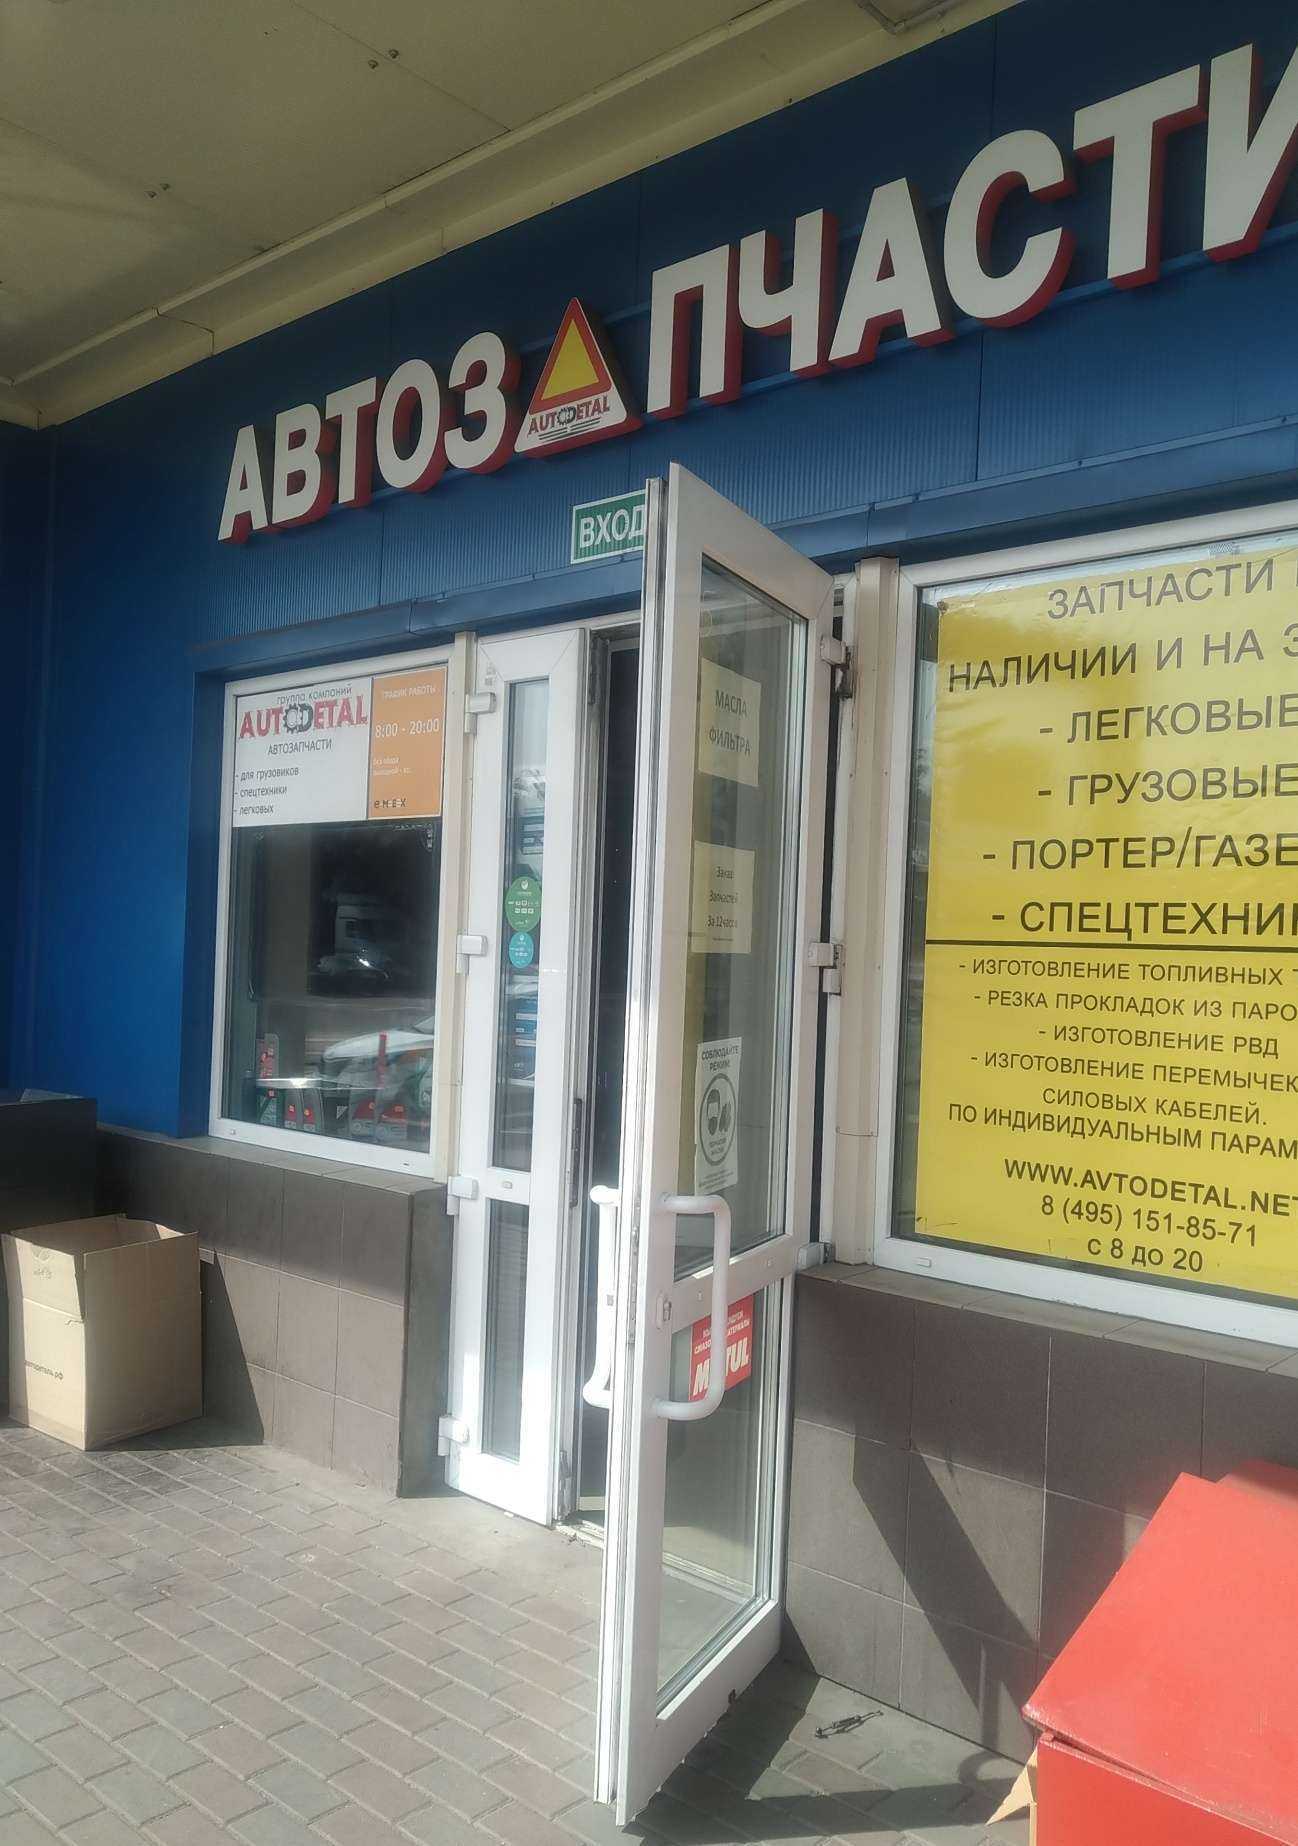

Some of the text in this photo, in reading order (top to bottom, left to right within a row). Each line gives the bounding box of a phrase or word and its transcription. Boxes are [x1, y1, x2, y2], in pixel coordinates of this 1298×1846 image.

[528, 395, 611, 438] AUTODETAL
[579, 504, 645, 549] ВХОД
[1047, 558, 1274, 620] ЗАПЧАСТИ
[948, 642, 1137, 693] НАЛИЧИИ
[1156, 636, 1183, 671] И
[1203, 628, 1265, 666] НА
[239, 694, 368, 740] AUTODETAL
[715, 689, 748, 718] МАСЛА
[1066, 692, 1298, 744] ЛЕГКОВЫЕ
[267, 738, 333, 756] АВТОЗАПЧАСТИ
[375, 723, 399, 738] 8:00
[409, 718, 440, 735] 20:00
[709, 726, 751, 757] ФИЛЬТРА
[240, 771, 255, 782] для
[256, 767, 300, 780] грузовиков
[1067, 763, 1298, 806] ГРУЗОВЫЕ
[1019, 901, 1298, 942] СПЕЦТЕХНИ
[972, 958, 1130, 981] ИЗГОТОВЛЕНИЕ
[1138, 963, 1284, 986] ТОПЛИВНЫХ
[987, 990, 1049, 1009] РЕЗКА
[1055, 993, 1185, 1017] ПРОКЛАДОК
[1193, 1000, 1223, 1018] ИЗ
[1231, 1001, 1298, 1022] ПАРО
[1054, 1025, 1224, 1052] ИЗГОТОВЛЕНИЕ
[1233, 1035, 1279, 1060] РВД
[984, 1052, 1145, 1081] ИЗГОТОВЛЕНИЕ
[1153, 1064, 1298, 1093] ПЕРЕМЫЧЕК
[1042, 1087, 1268, 1126] СИЛОВЫХ КАБЕЛЕЙ.
[948, 1102, 1298, 1160] ПО ИНДИВИДУАЛЬНЫМ ПАРАМ
[1041, 1194, 1257, 1248] 8 (495) 151-85-71
[1110, 1237, 1124, 1259] 8
[1172, 1247, 1203, 1272] 20
